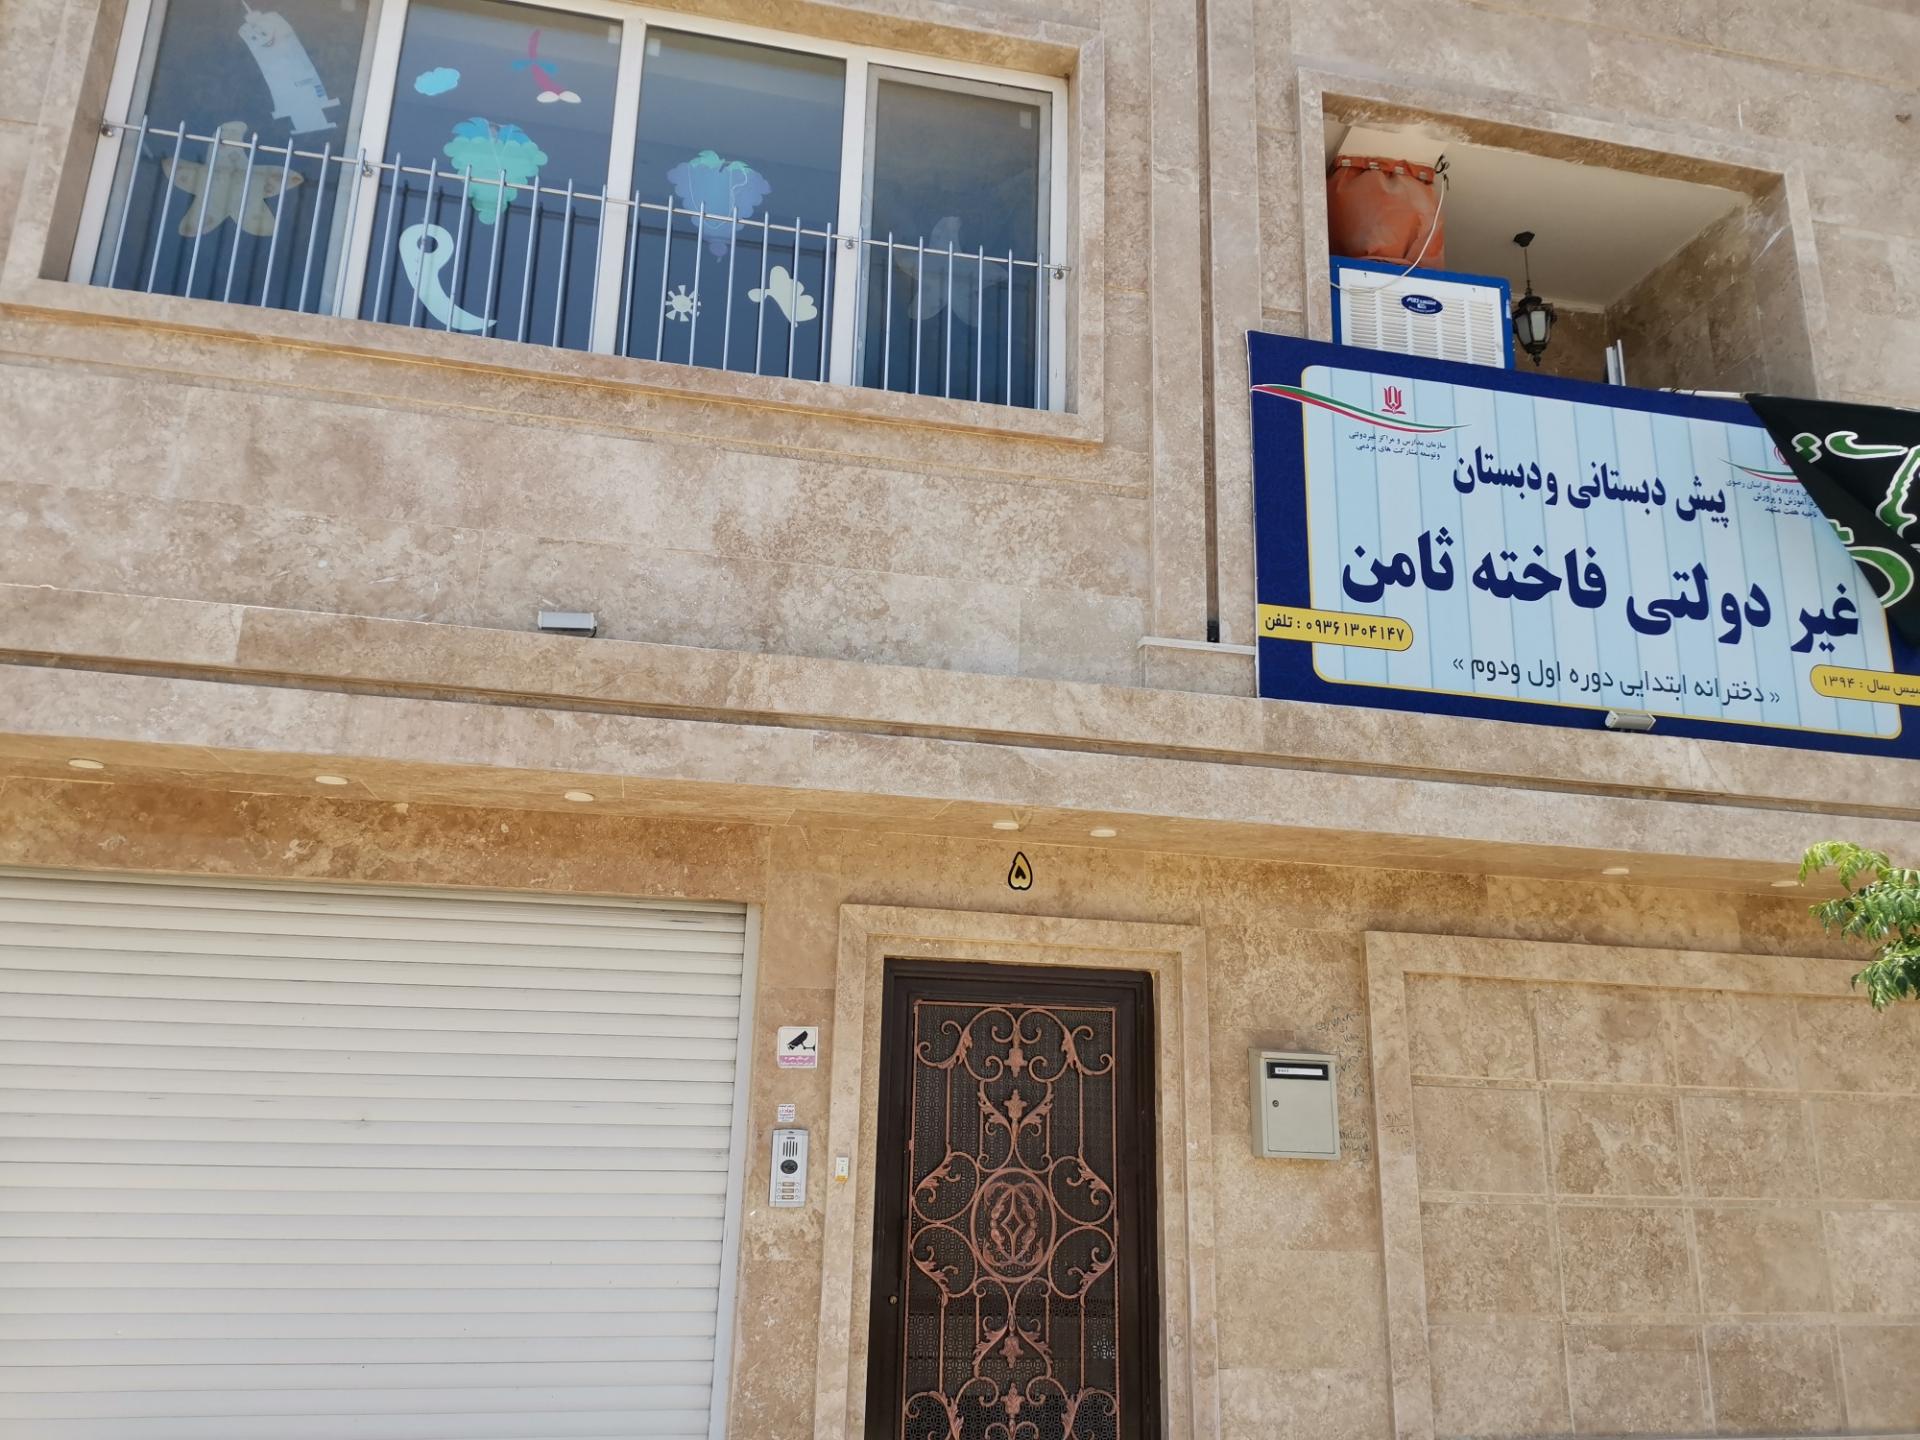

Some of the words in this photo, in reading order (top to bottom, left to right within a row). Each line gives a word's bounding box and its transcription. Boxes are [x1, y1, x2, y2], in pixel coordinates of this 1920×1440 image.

[1567, 461, 1667, 515] دبستانی
[1676, 474, 1729, 528] پیش
[1342, 526, 1454, 604] ثامن
[1472, 544, 1607, 609] فاخته
[1626, 561, 1771, 645] دولتی
[1790, 582, 1859, 654] غیر
[1264, 613, 1293, 631] تلفن
[1306, 619, 1405, 642] ۰۹۳۶۱۳۰۴۱۴۷
[1527, 659, 1561, 687] اول
[1569, 667, 1614, 693] دوره
[1619, 669, 1687, 702] ابتدایی
[1823, 675, 1855, 689] ۱۳۹۴
[1867, 679, 1890, 693] سال
[1694, 678, 1765, 705] دخترانه
[1007, 851, 1033, 890] ۵
